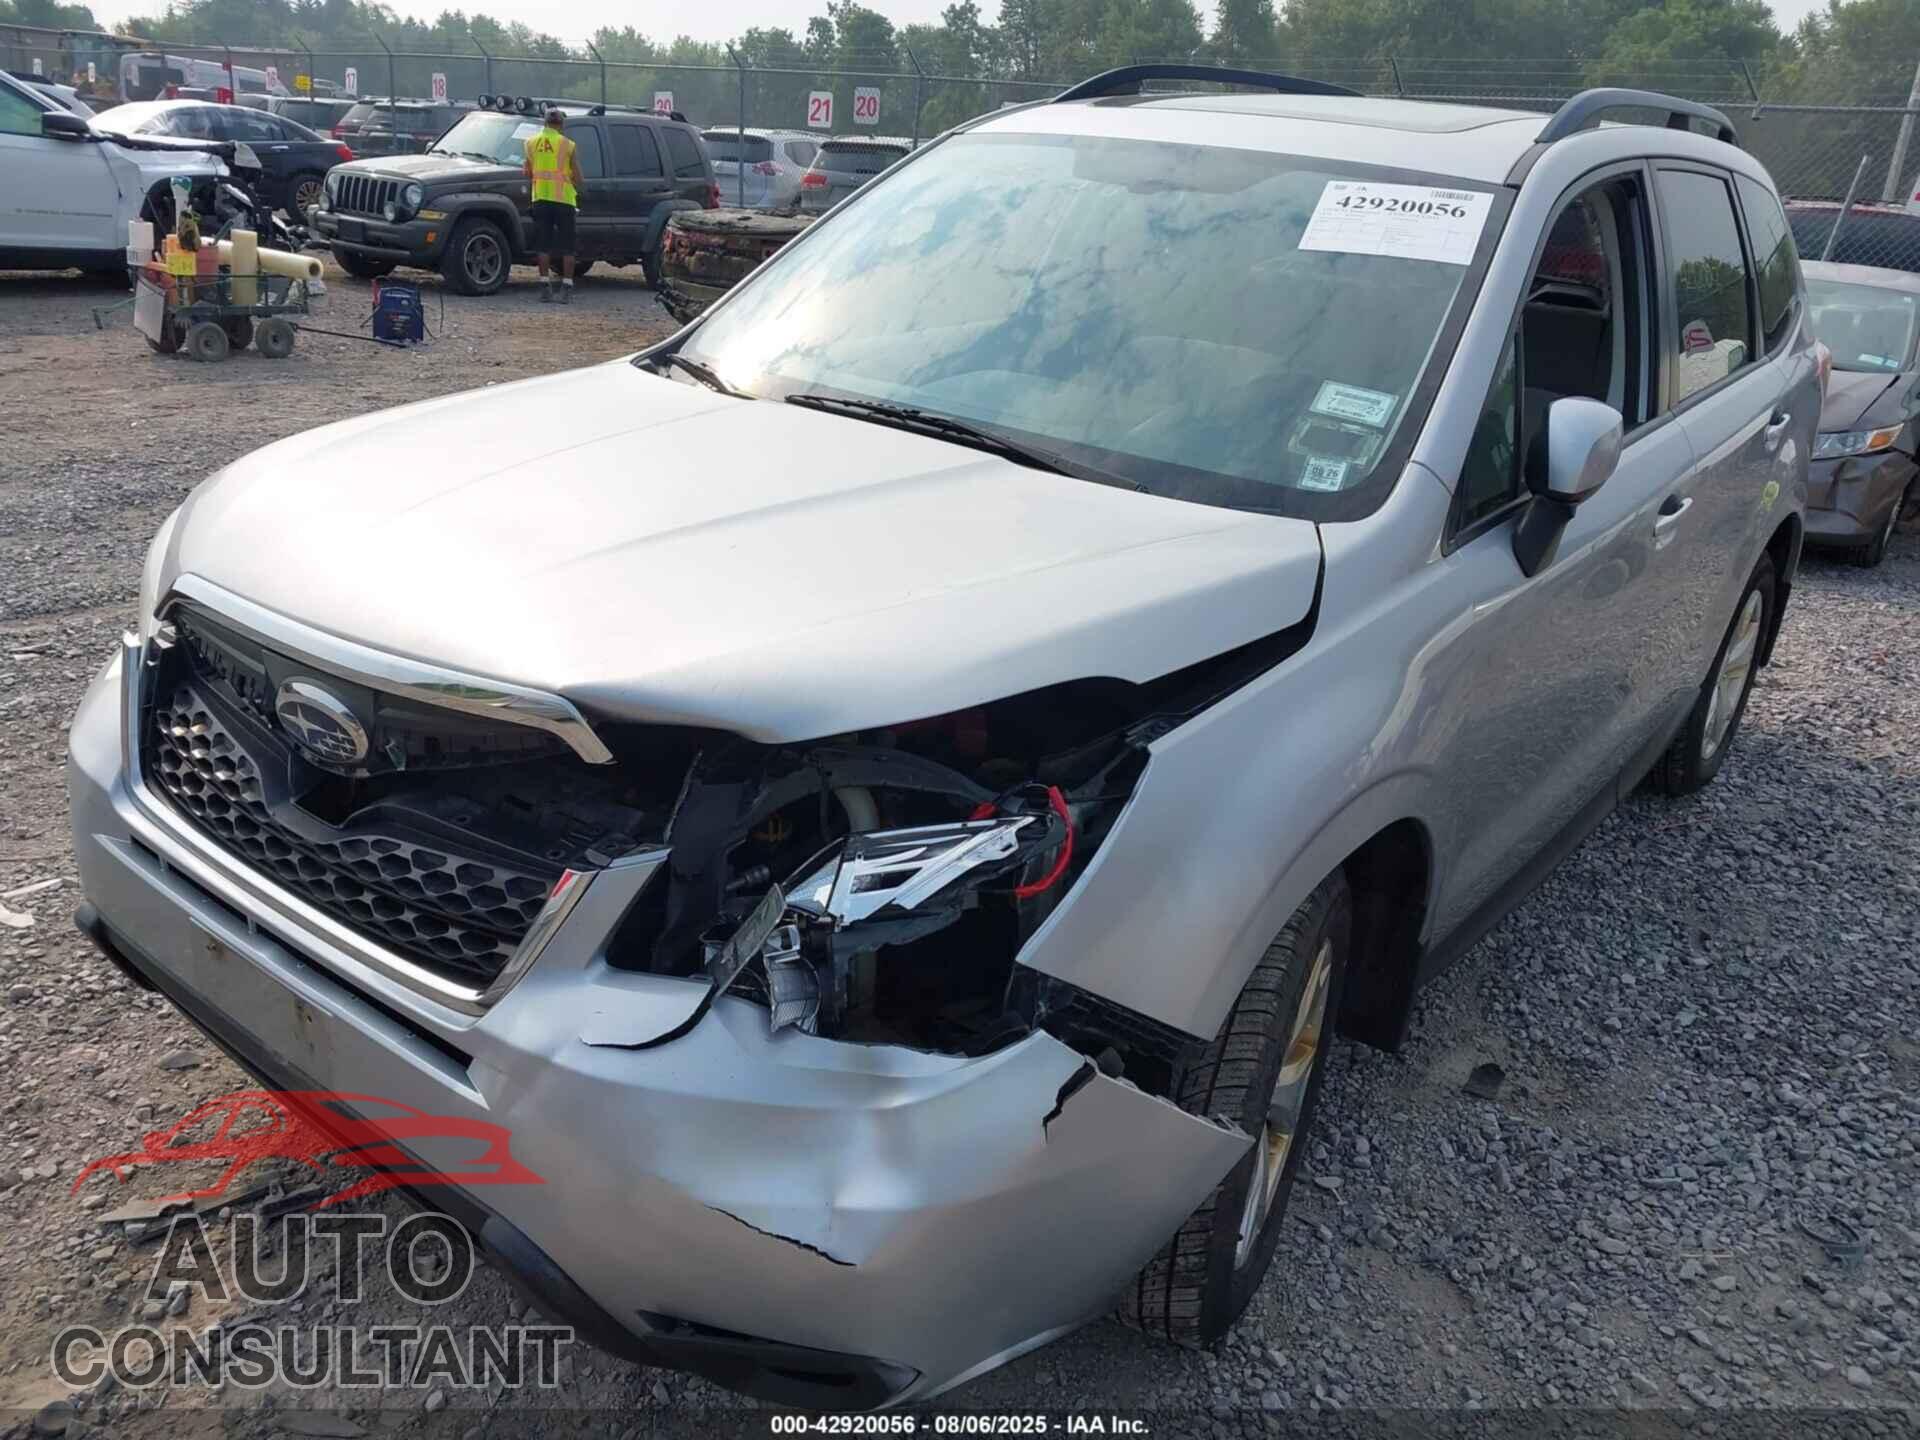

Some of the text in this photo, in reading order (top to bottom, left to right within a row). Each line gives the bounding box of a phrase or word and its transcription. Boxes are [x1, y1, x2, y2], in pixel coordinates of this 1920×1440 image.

[346, 72, 356, 89] 17
[433, 78, 445, 97] 18
[809, 97, 831, 123] 21
[855, 95, 877, 117] 20
[1336, 195, 1466, 219] 42920056
